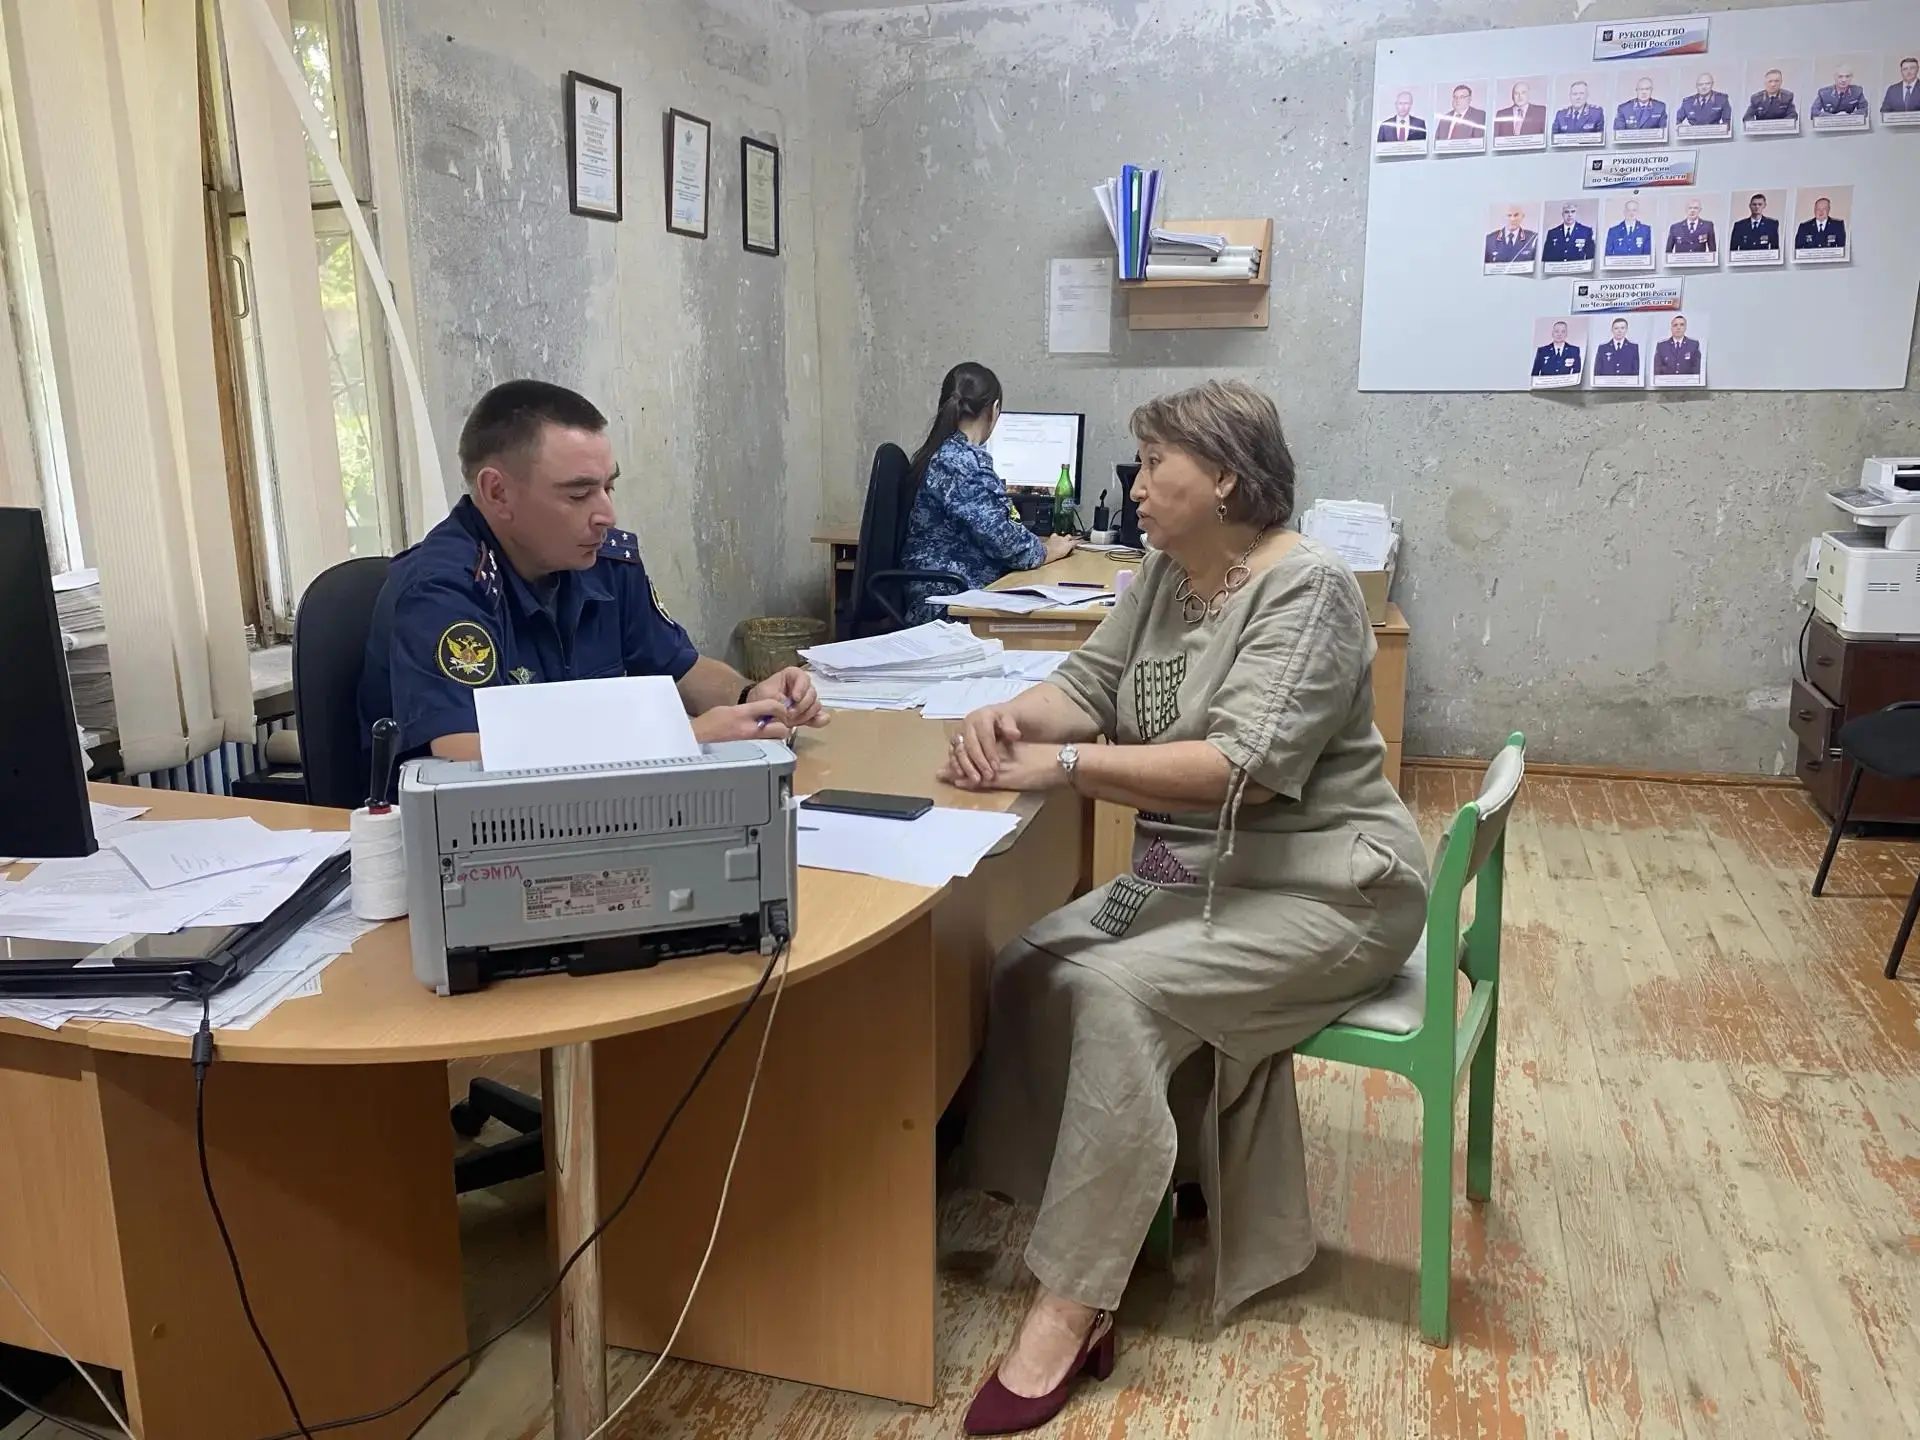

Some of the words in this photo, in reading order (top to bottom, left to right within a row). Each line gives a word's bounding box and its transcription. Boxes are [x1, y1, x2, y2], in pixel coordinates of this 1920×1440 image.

[1619, 28, 1685, 39] РУКОВОДСТВО
[1621, 41, 1647, 50] ФСИН
[1649, 40, 1681, 48] России
[1612, 157, 1669, 165] РУКОВОДСТВО
[1603, 175, 1653, 183] Челябинской
[1600, 283, 1655, 291] РУКОВОДСТВО
[1591, 300, 1640, 308] Челябинской
